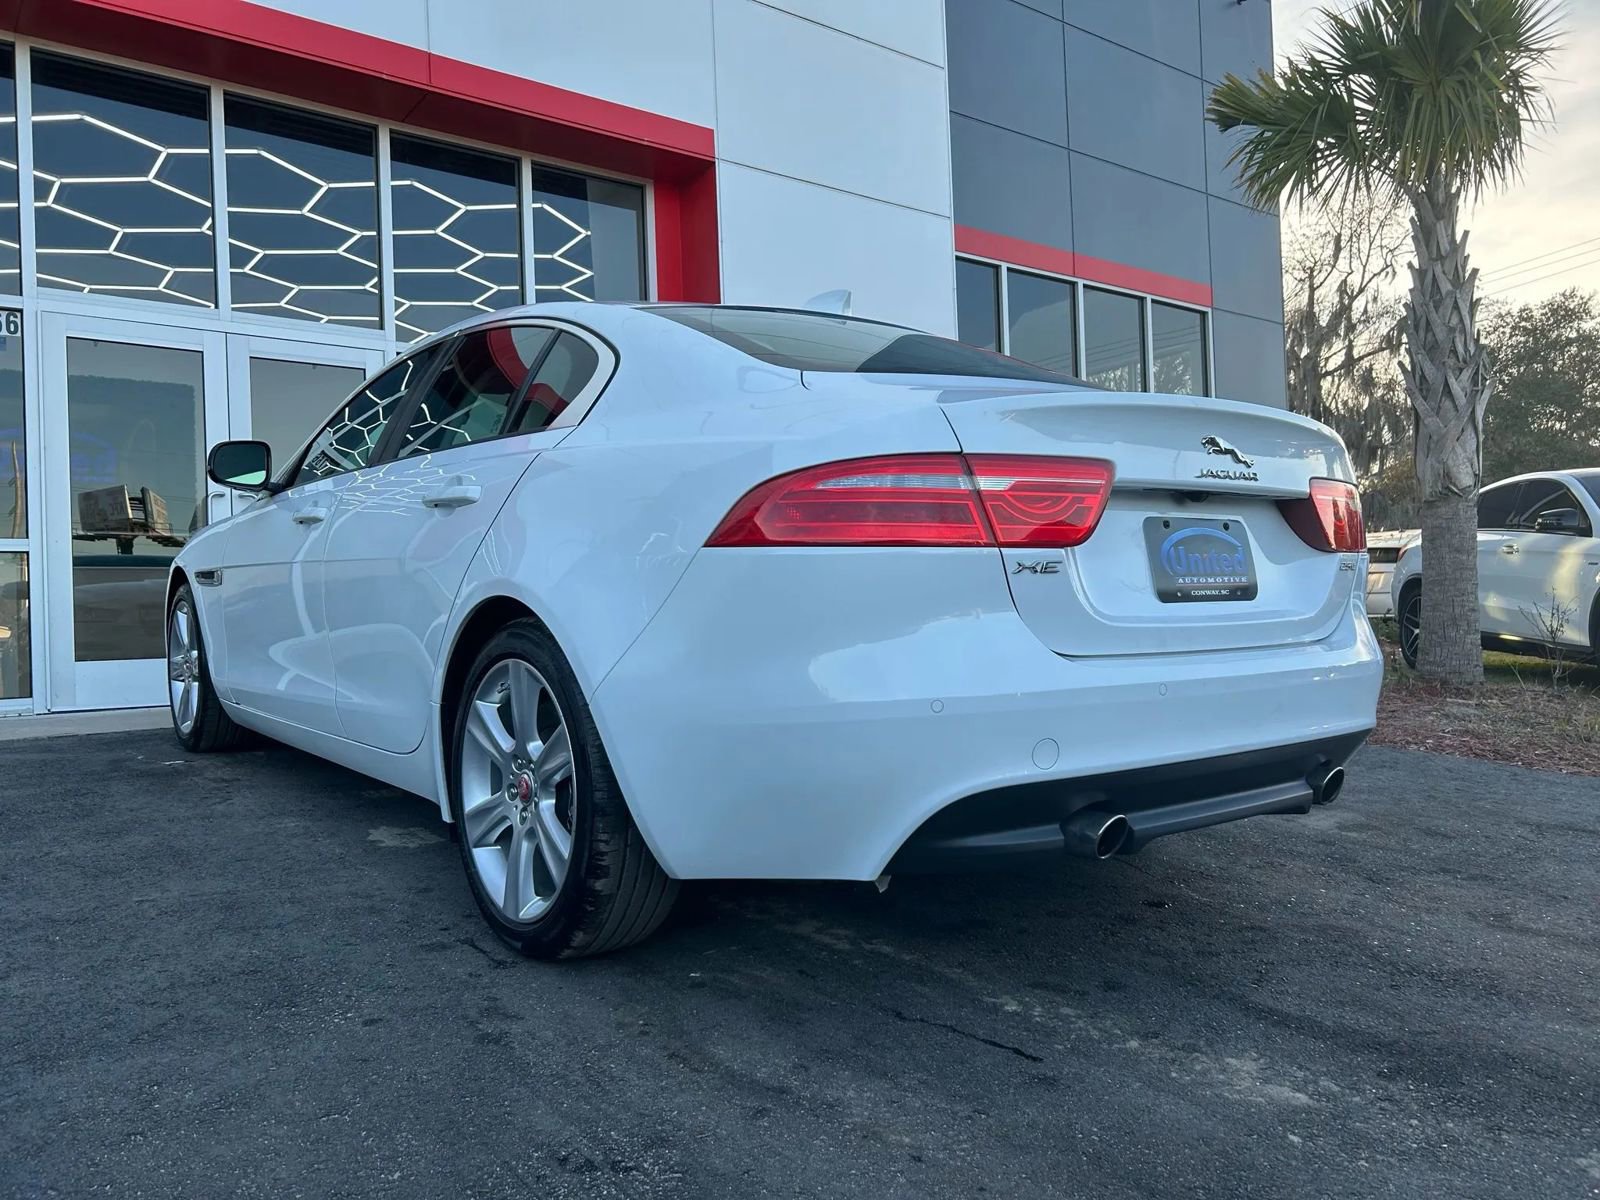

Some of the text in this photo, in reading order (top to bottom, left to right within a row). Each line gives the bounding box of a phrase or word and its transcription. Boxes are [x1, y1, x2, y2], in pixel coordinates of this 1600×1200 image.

[0, 312, 19, 335] 6
[1194, 468, 1259, 481] JAGUAR
[1168, 545, 1248, 574] United
[1011, 560, 1063, 574] XE
[1178, 576, 1248, 584] AUTOMOTIVE
